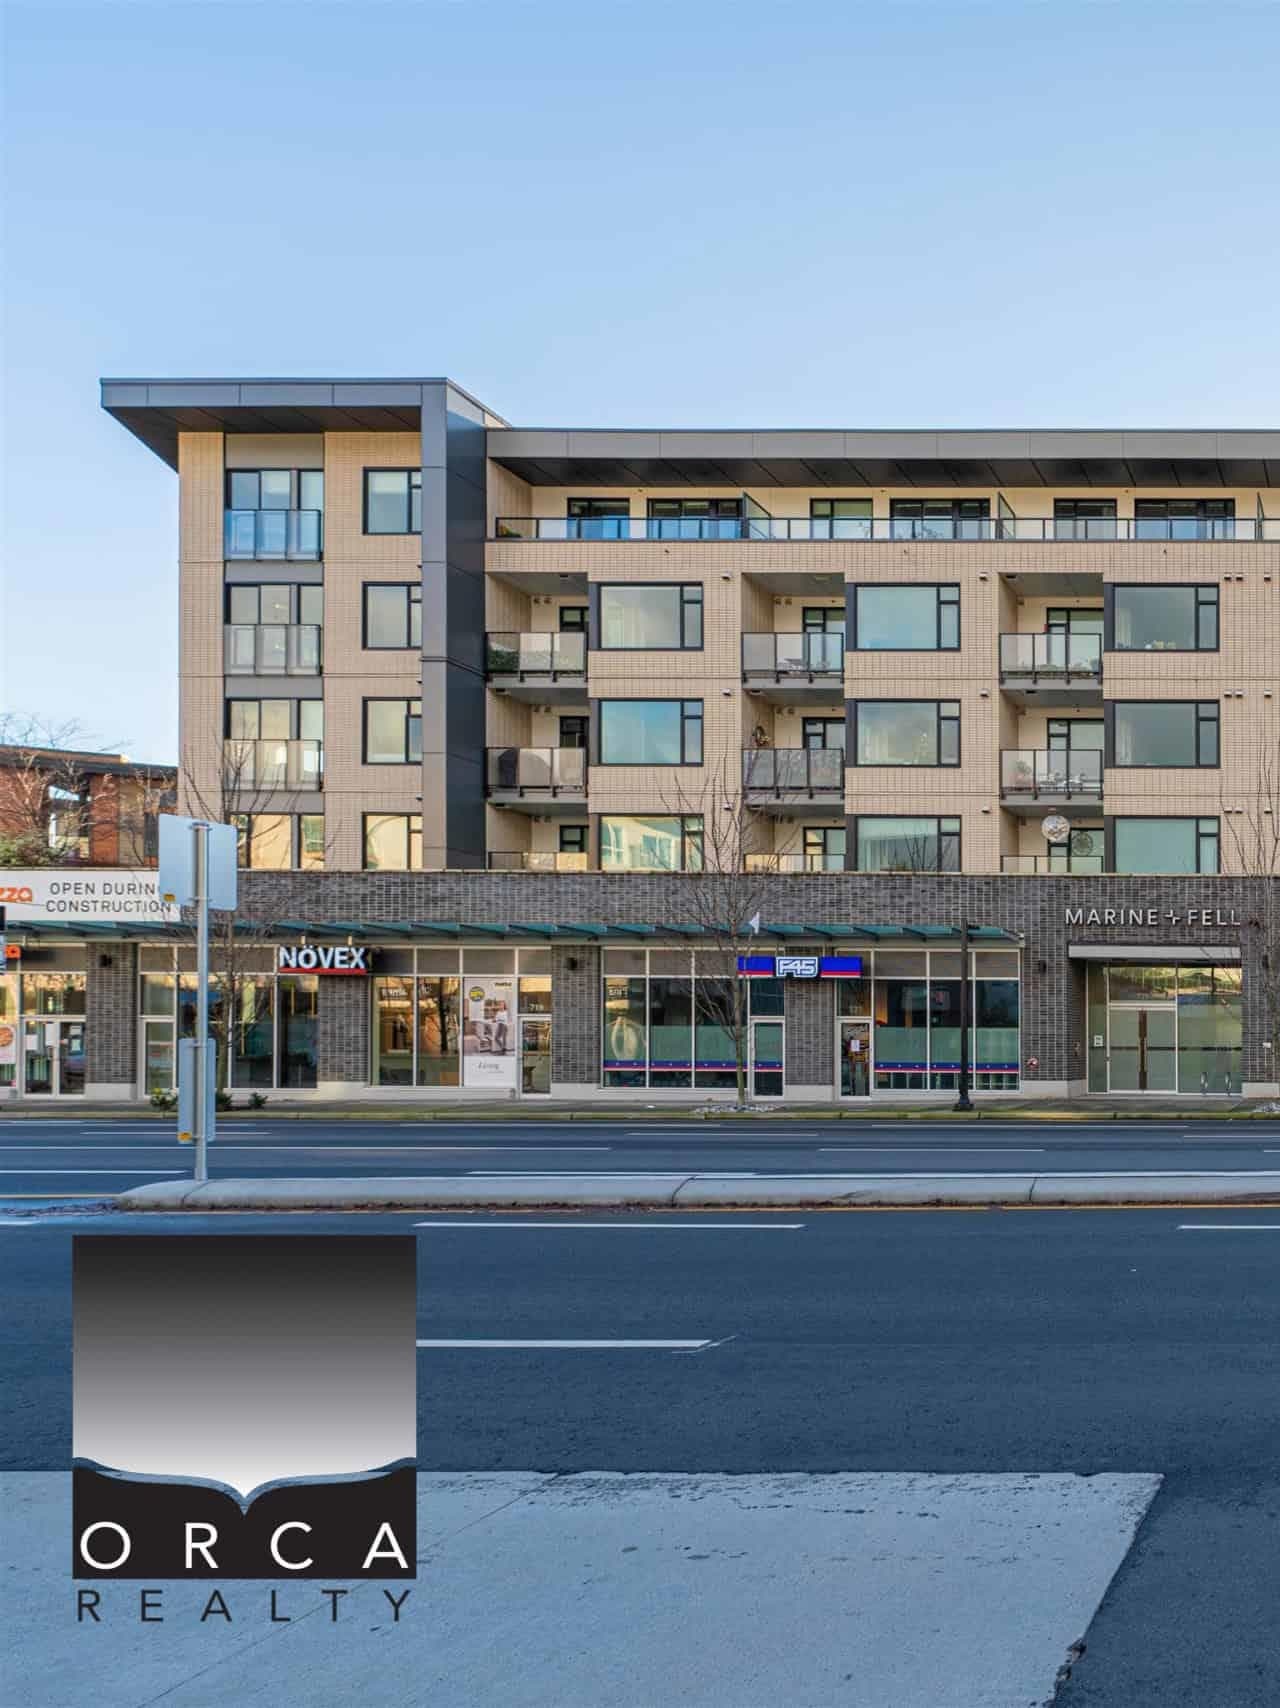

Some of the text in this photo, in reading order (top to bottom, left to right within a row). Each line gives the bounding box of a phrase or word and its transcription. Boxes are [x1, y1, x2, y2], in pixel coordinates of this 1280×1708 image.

[50, 882, 159, 896] OPEN DURIN
[45, 900, 172, 913] CONSTRUCTION
[1065, 908, 1159, 926] MARINE
[1187, 909, 1241, 926] FELL
[279, 945, 366, 968] NÖVEX
[778, 958, 816, 976] F45
